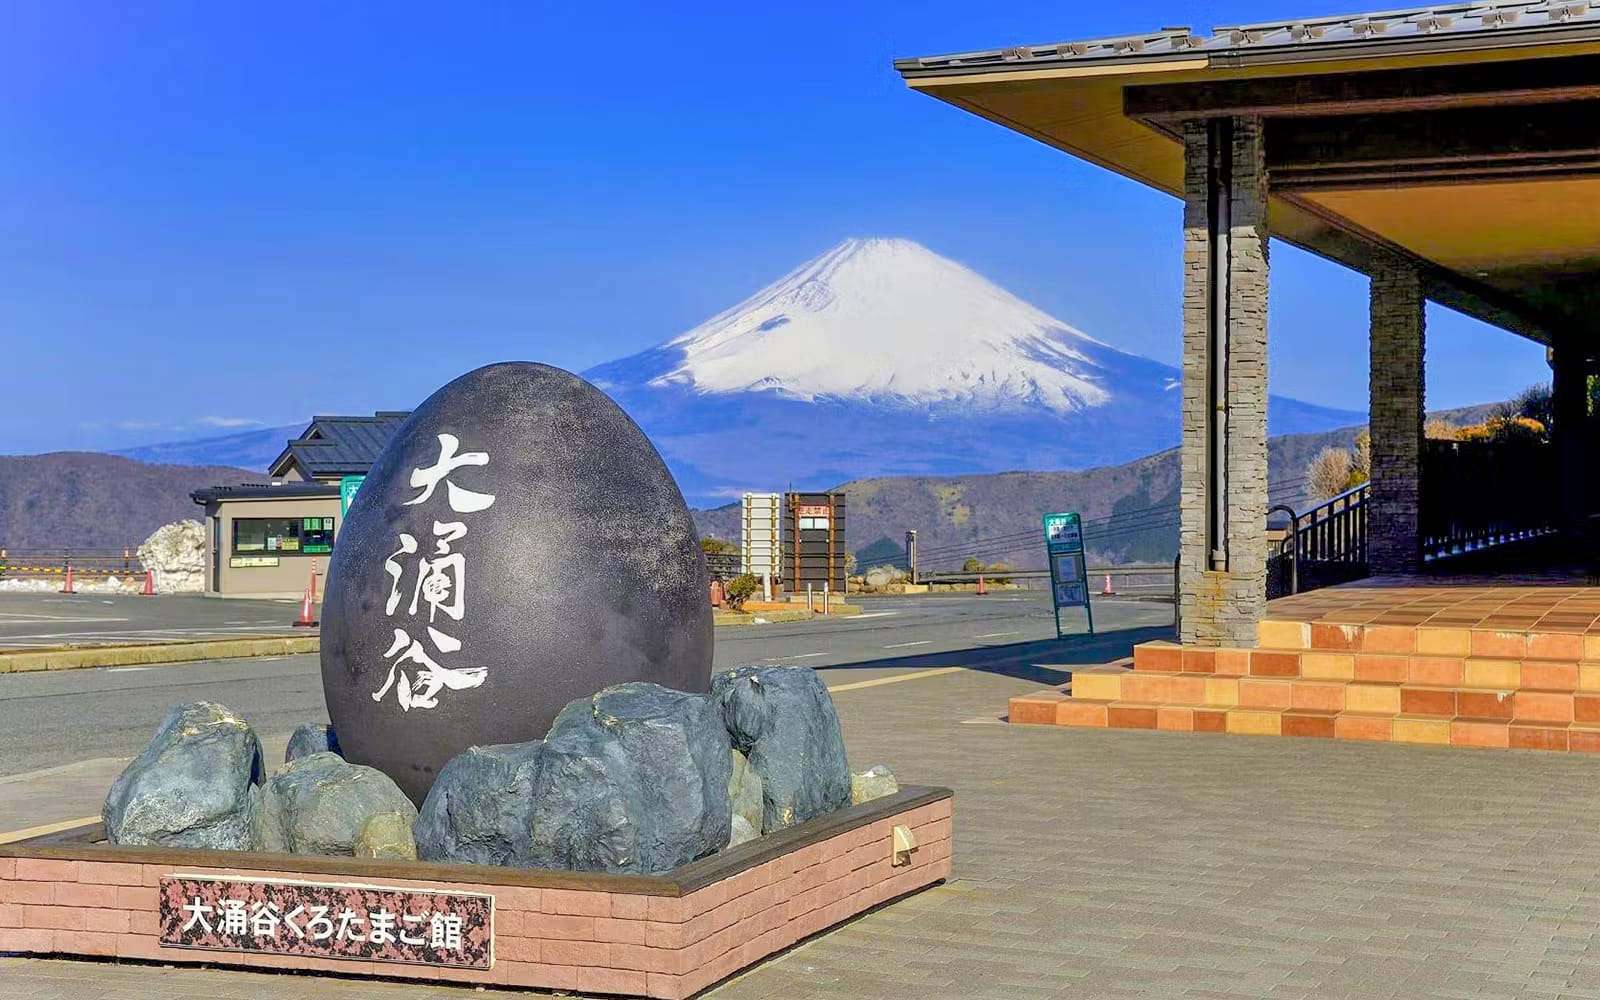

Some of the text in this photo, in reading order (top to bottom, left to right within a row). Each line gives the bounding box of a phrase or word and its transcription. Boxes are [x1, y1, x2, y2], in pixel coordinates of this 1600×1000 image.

[372, 433, 495, 711] 大涌谷
[182, 896, 463, 950] 大涌谷くろたまご館
